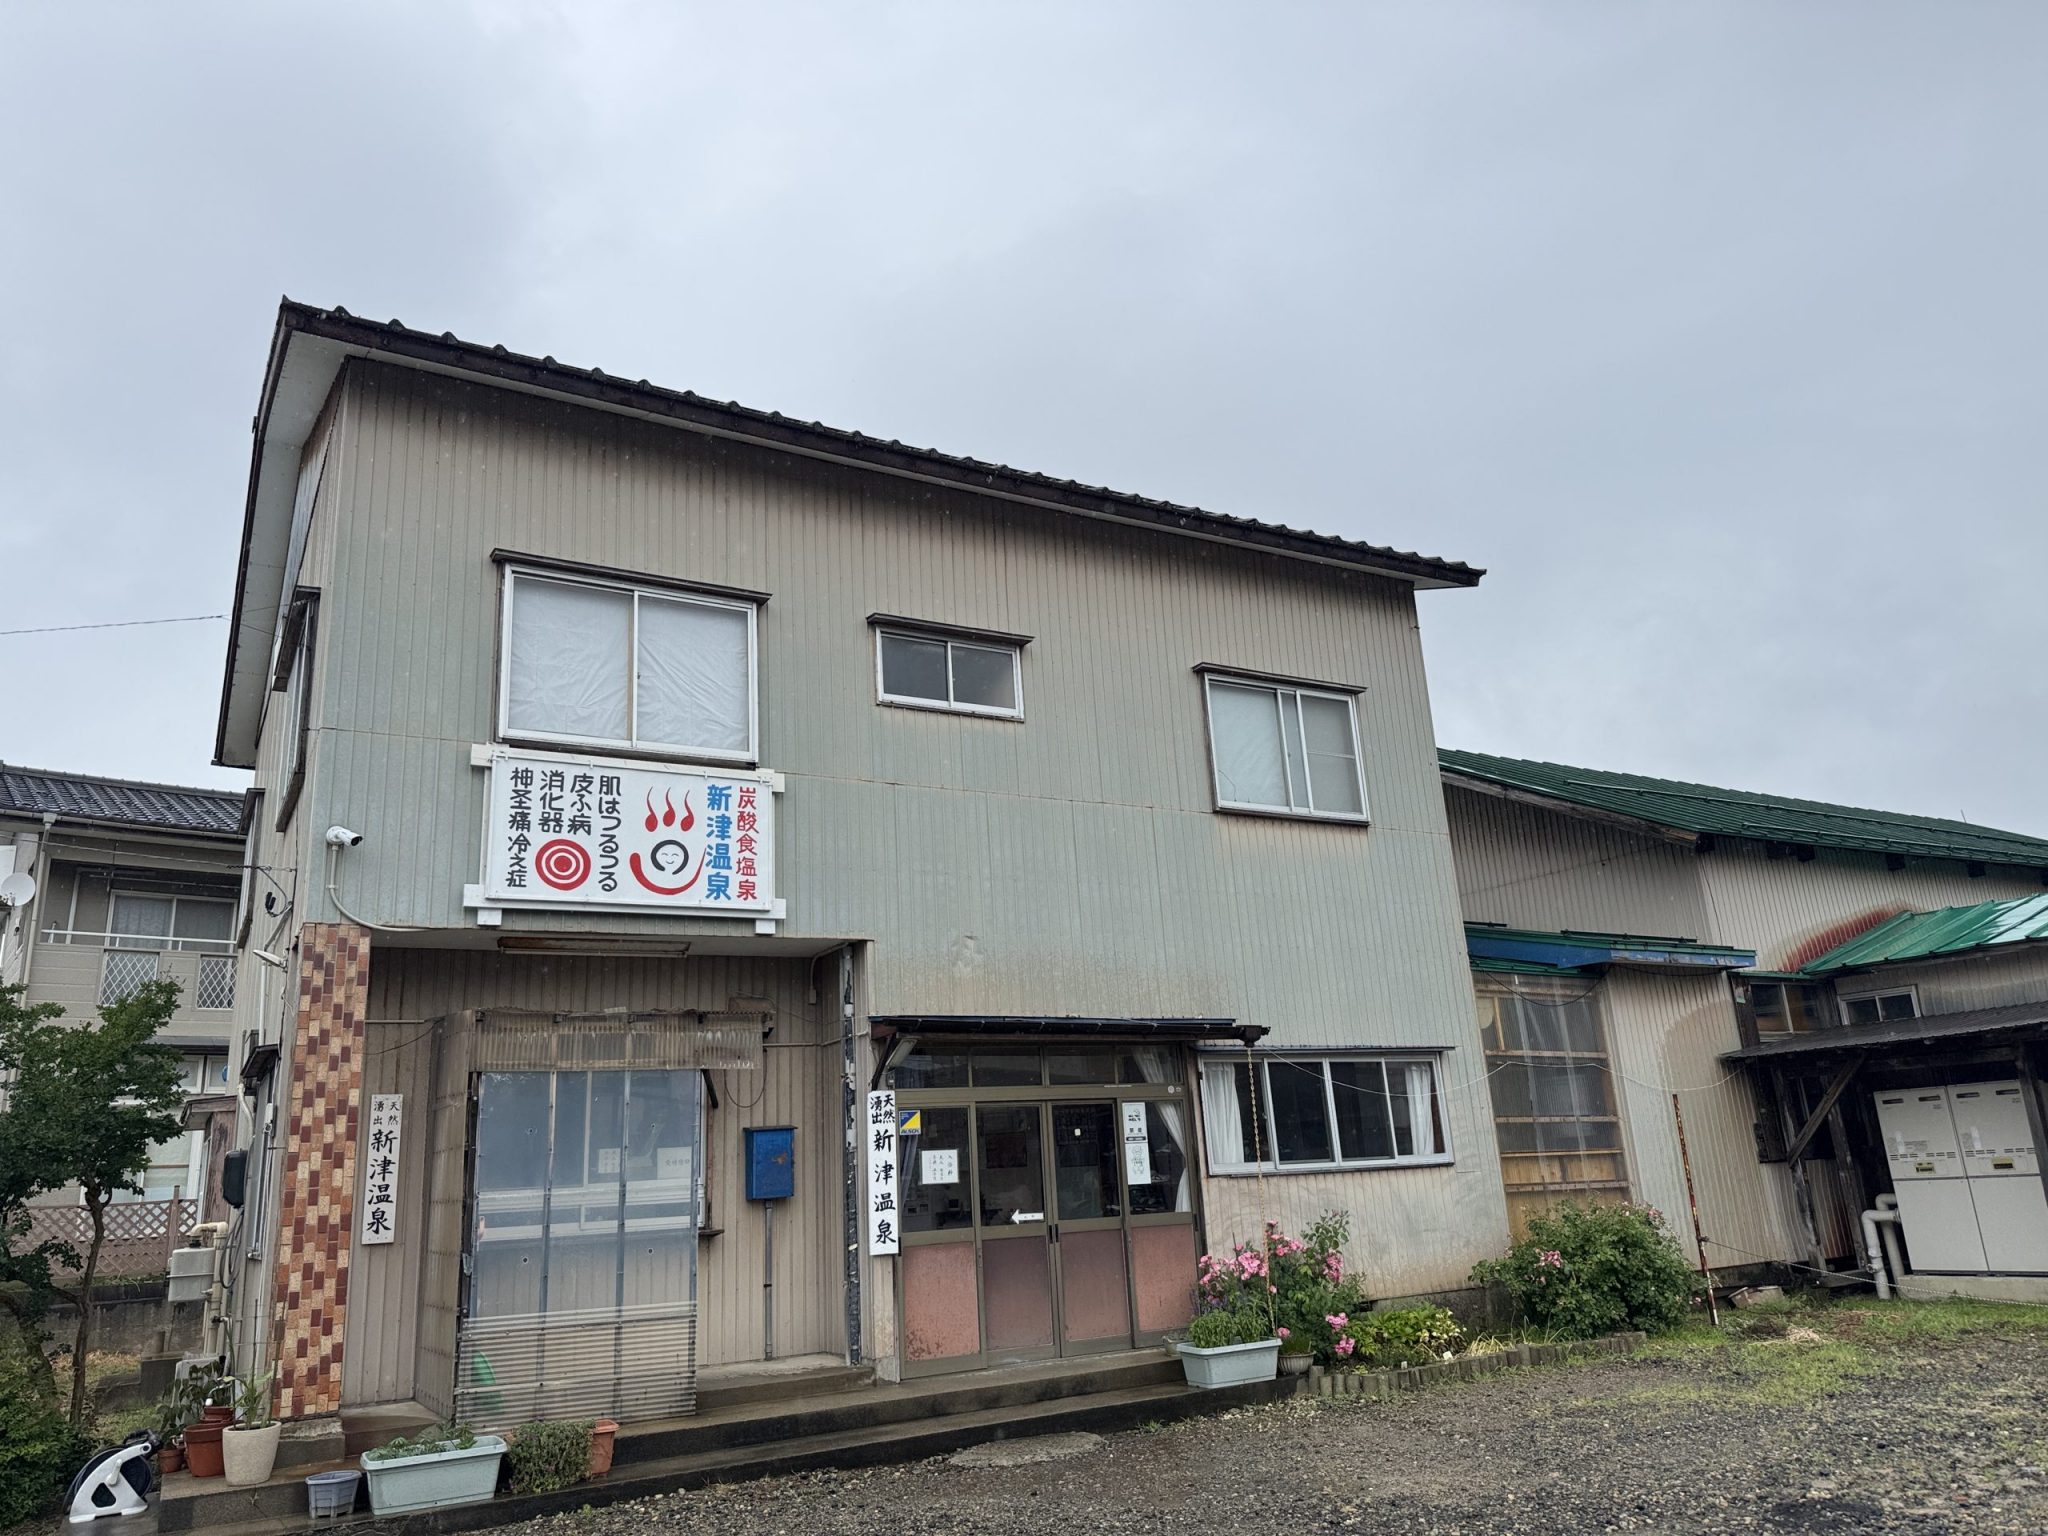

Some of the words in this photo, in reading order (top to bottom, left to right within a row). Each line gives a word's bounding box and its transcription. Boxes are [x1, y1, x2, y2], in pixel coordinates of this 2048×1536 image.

[538, 769, 565, 834] 消化器
[567, 772, 594, 836] 皮ふ病
[598, 775, 622, 893] 肌はつるつる
[705, 784, 732, 901] 新津温泉
[736, 785, 759, 901] 炭酸食塩泉
[373, 1101, 384, 1125] 湧出
[387, 1101, 400, 1125] 天然
[870, 1095, 882, 1124] 湧出
[882, 1093, 895, 1124] 天然
[366, 1129, 398, 1235] 新津温泉
[874, 1128, 897, 1244] 新津温泉
